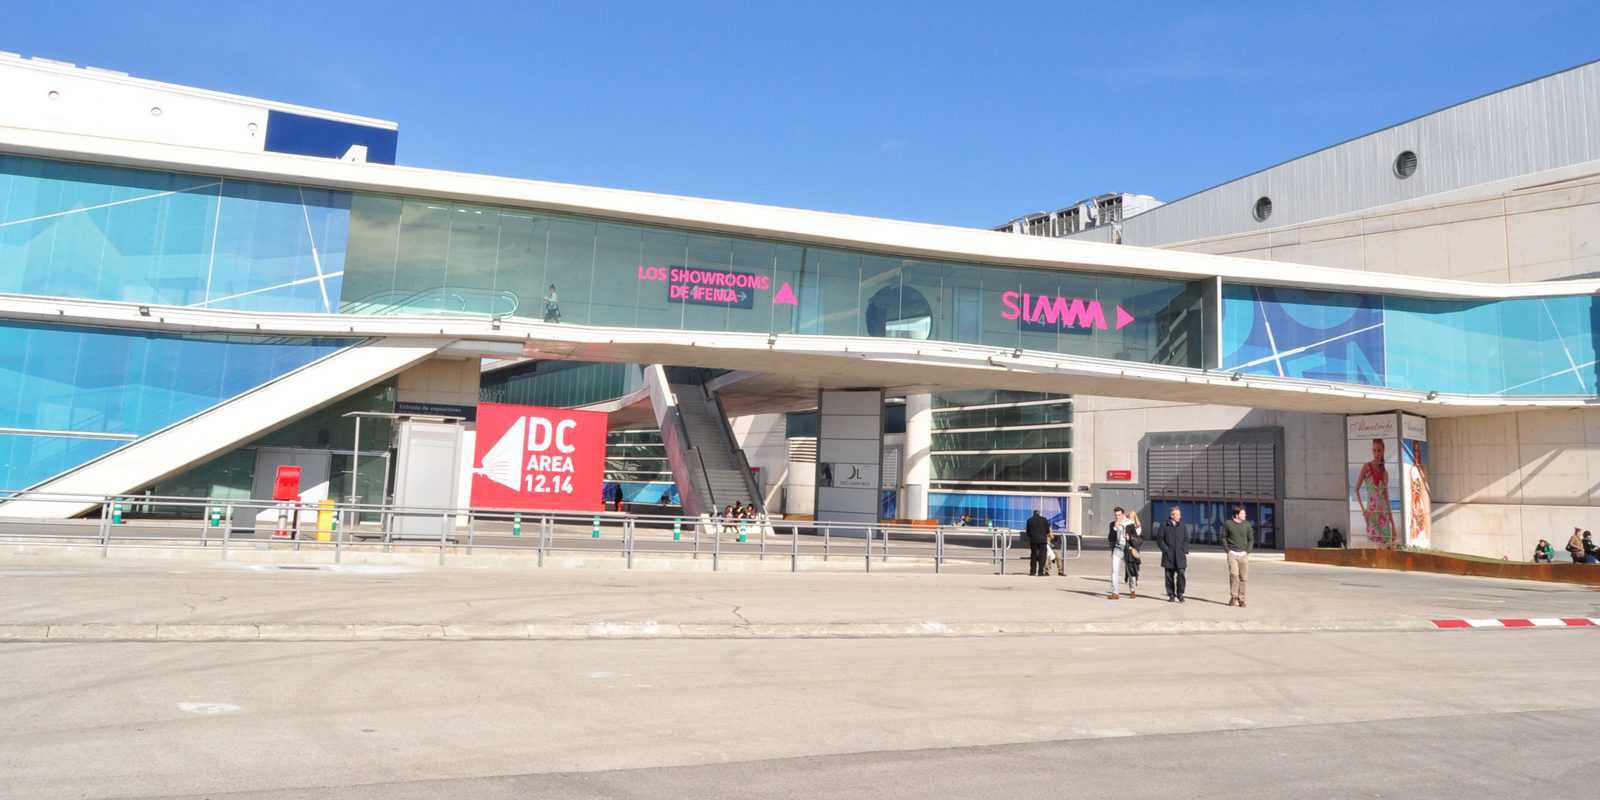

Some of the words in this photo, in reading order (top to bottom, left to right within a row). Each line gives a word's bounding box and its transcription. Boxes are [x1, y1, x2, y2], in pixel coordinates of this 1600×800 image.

[638, 266, 667, 281] LOS
[670, 268, 769, 290] SHOWROOMS
[670, 285, 690, 299] DE
[693, 286, 738, 303] IFEMA
[526, 454, 574, 472] AREA
[525, 474, 573, 494] 12.14
